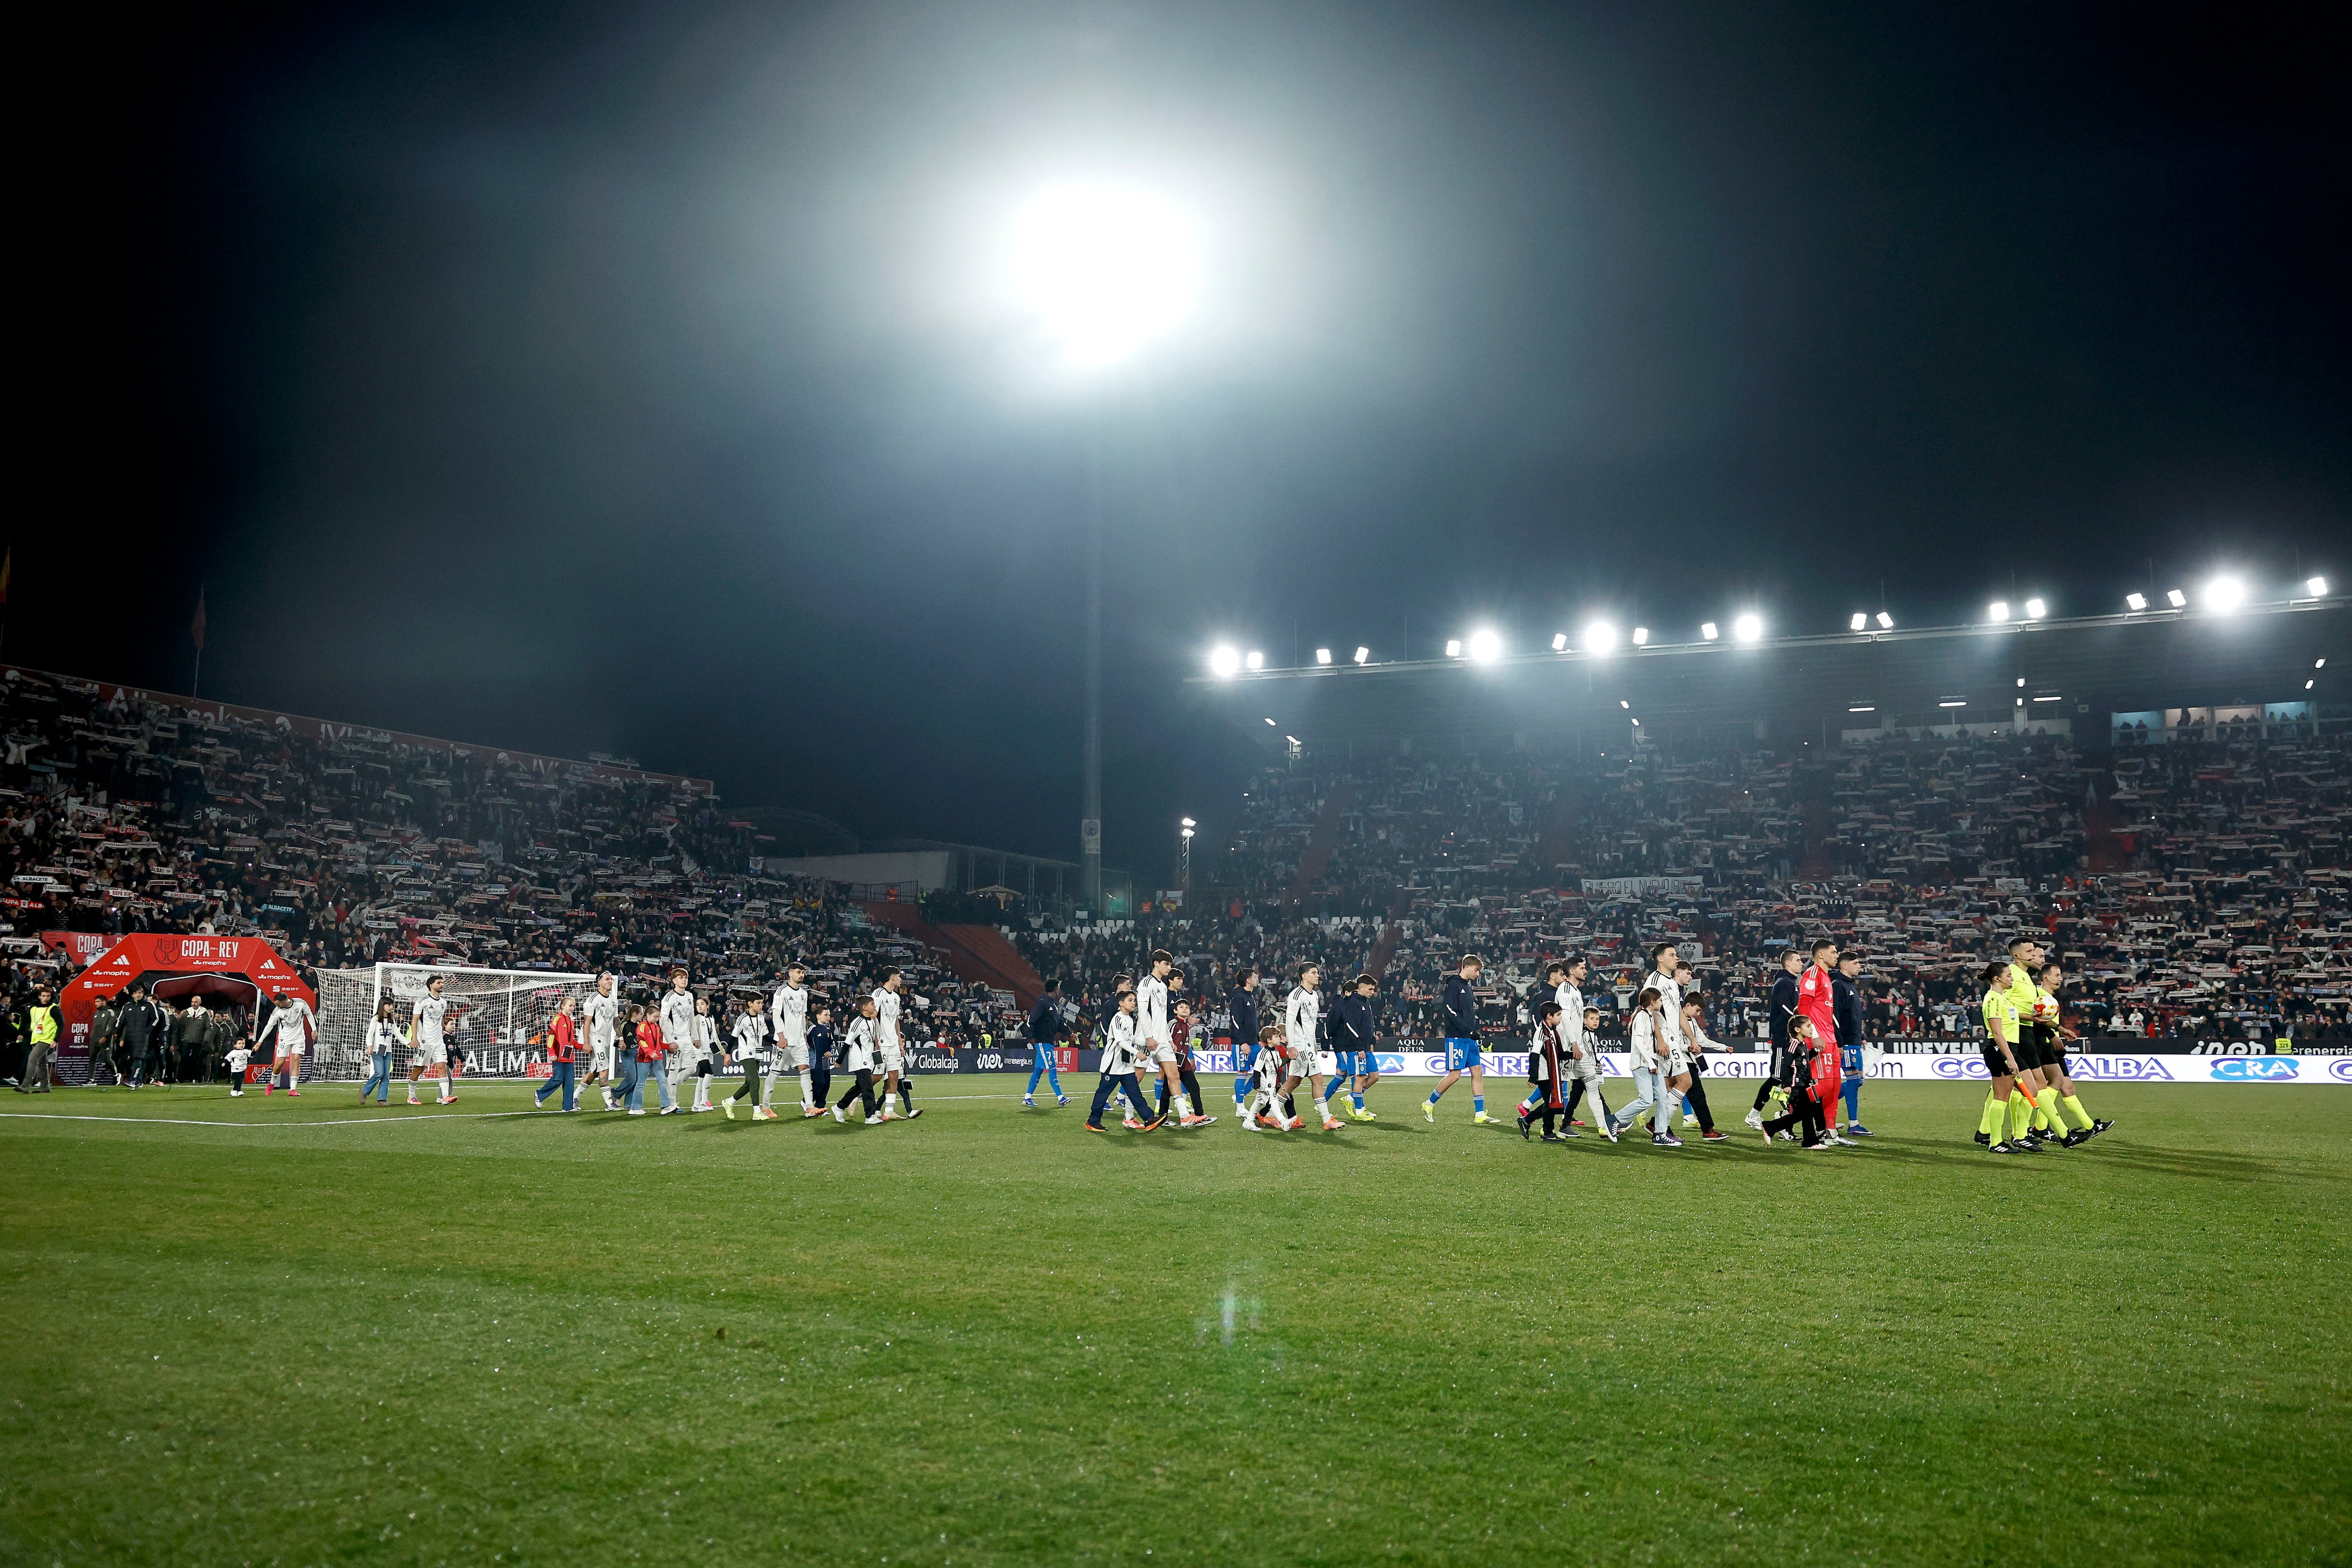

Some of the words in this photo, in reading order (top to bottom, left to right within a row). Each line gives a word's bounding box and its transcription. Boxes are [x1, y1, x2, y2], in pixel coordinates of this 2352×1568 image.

[182, 940, 210, 957] COPA
[219, 941, 239, 958] REY
[72, 1023, 88, 1033] COPA
[418, 1049, 426, 1058] 17
[596, 1051, 605, 1061] 19
[673, 1050, 681, 1059] 27
[777, 1051, 783, 1060] 6
[1045, 1051, 1052, 1060] 7
[1063, 1051, 1072, 1064] REY
[1308, 1052, 1315, 1062] 2
[1453, 1049, 1464, 1059] 24
[1674, 1049, 1680, 1060] 5
[1822, 1053, 1832, 1064] 13
[918, 1053, 959, 1074] Globalcaja
[977, 1052, 1003, 1070] iner
[1004, 1055, 1033, 1066] inerenergia.es
[2215, 1059, 2297, 1077] CRA
